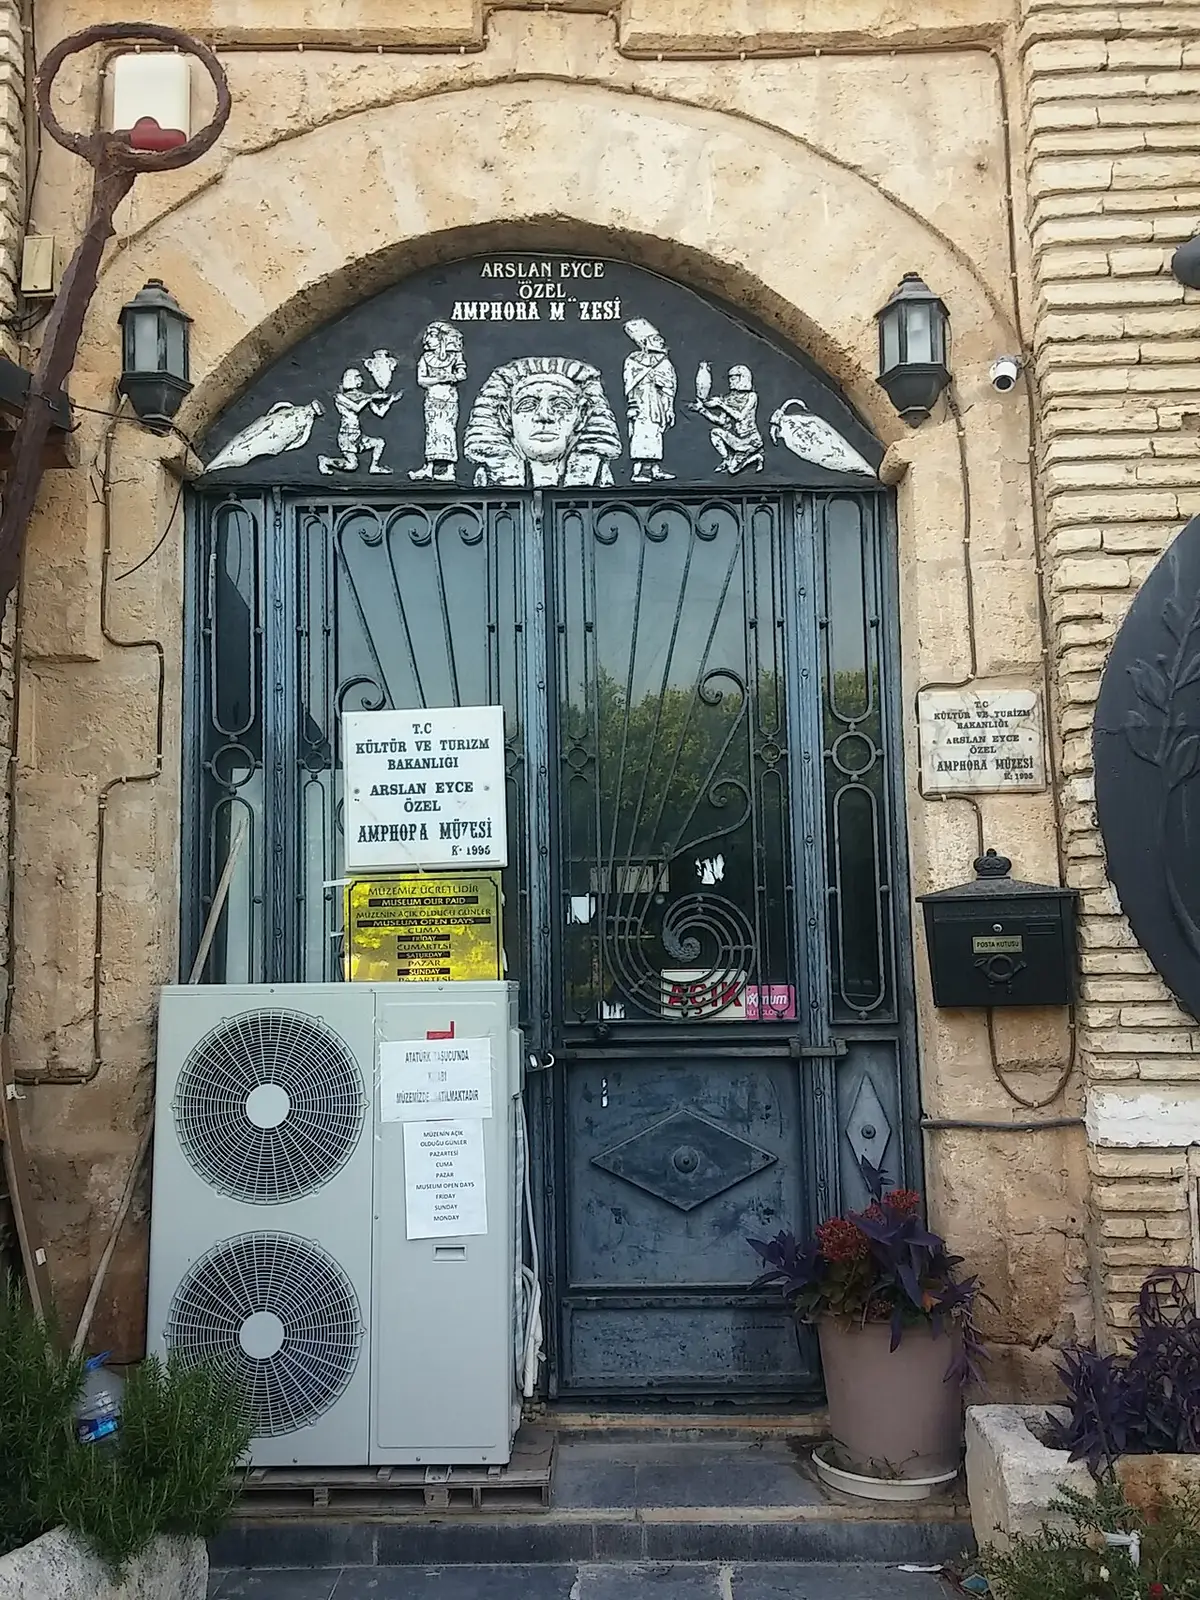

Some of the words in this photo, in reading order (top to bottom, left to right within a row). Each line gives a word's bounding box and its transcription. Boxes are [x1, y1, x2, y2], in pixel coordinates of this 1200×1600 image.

[480, 262, 551, 278] ARSLAN
[560, 262, 605, 278] EYCE
[518, 280, 566, 299] ÖZEL
[451, 301, 540, 320] AMPHORA
[934, 709, 971, 720] KÜLTÜR
[994, 708, 1031, 718] TURİZM
[946, 735, 986, 744] ARSLAN
[992, 734, 1019, 743] EYCE
[356, 738, 407, 754] KÜLTÜR
[415, 740, 432, 751] VE
[969, 746, 997, 754] ÖZEL
[937, 759, 987, 772] AMPHORA
[995, 755, 1034, 770] MÜZESİ
[369, 782, 427, 796] ARSLAN
[435, 781, 474, 794] EYCE
[404, 798, 441, 812] ÖZEL
[381, 898, 422, 907] MUSEUM
[423, 897, 444, 906] OUR
[445, 897, 466, 905] PAID
[372, 919, 418, 927] MUSEUM
[450, 917, 475, 925] DAYS
[407, 926, 442, 934] CUMA
[407, 959, 441, 967] PAZAR
[409, 968, 441, 976] SUNDAY
